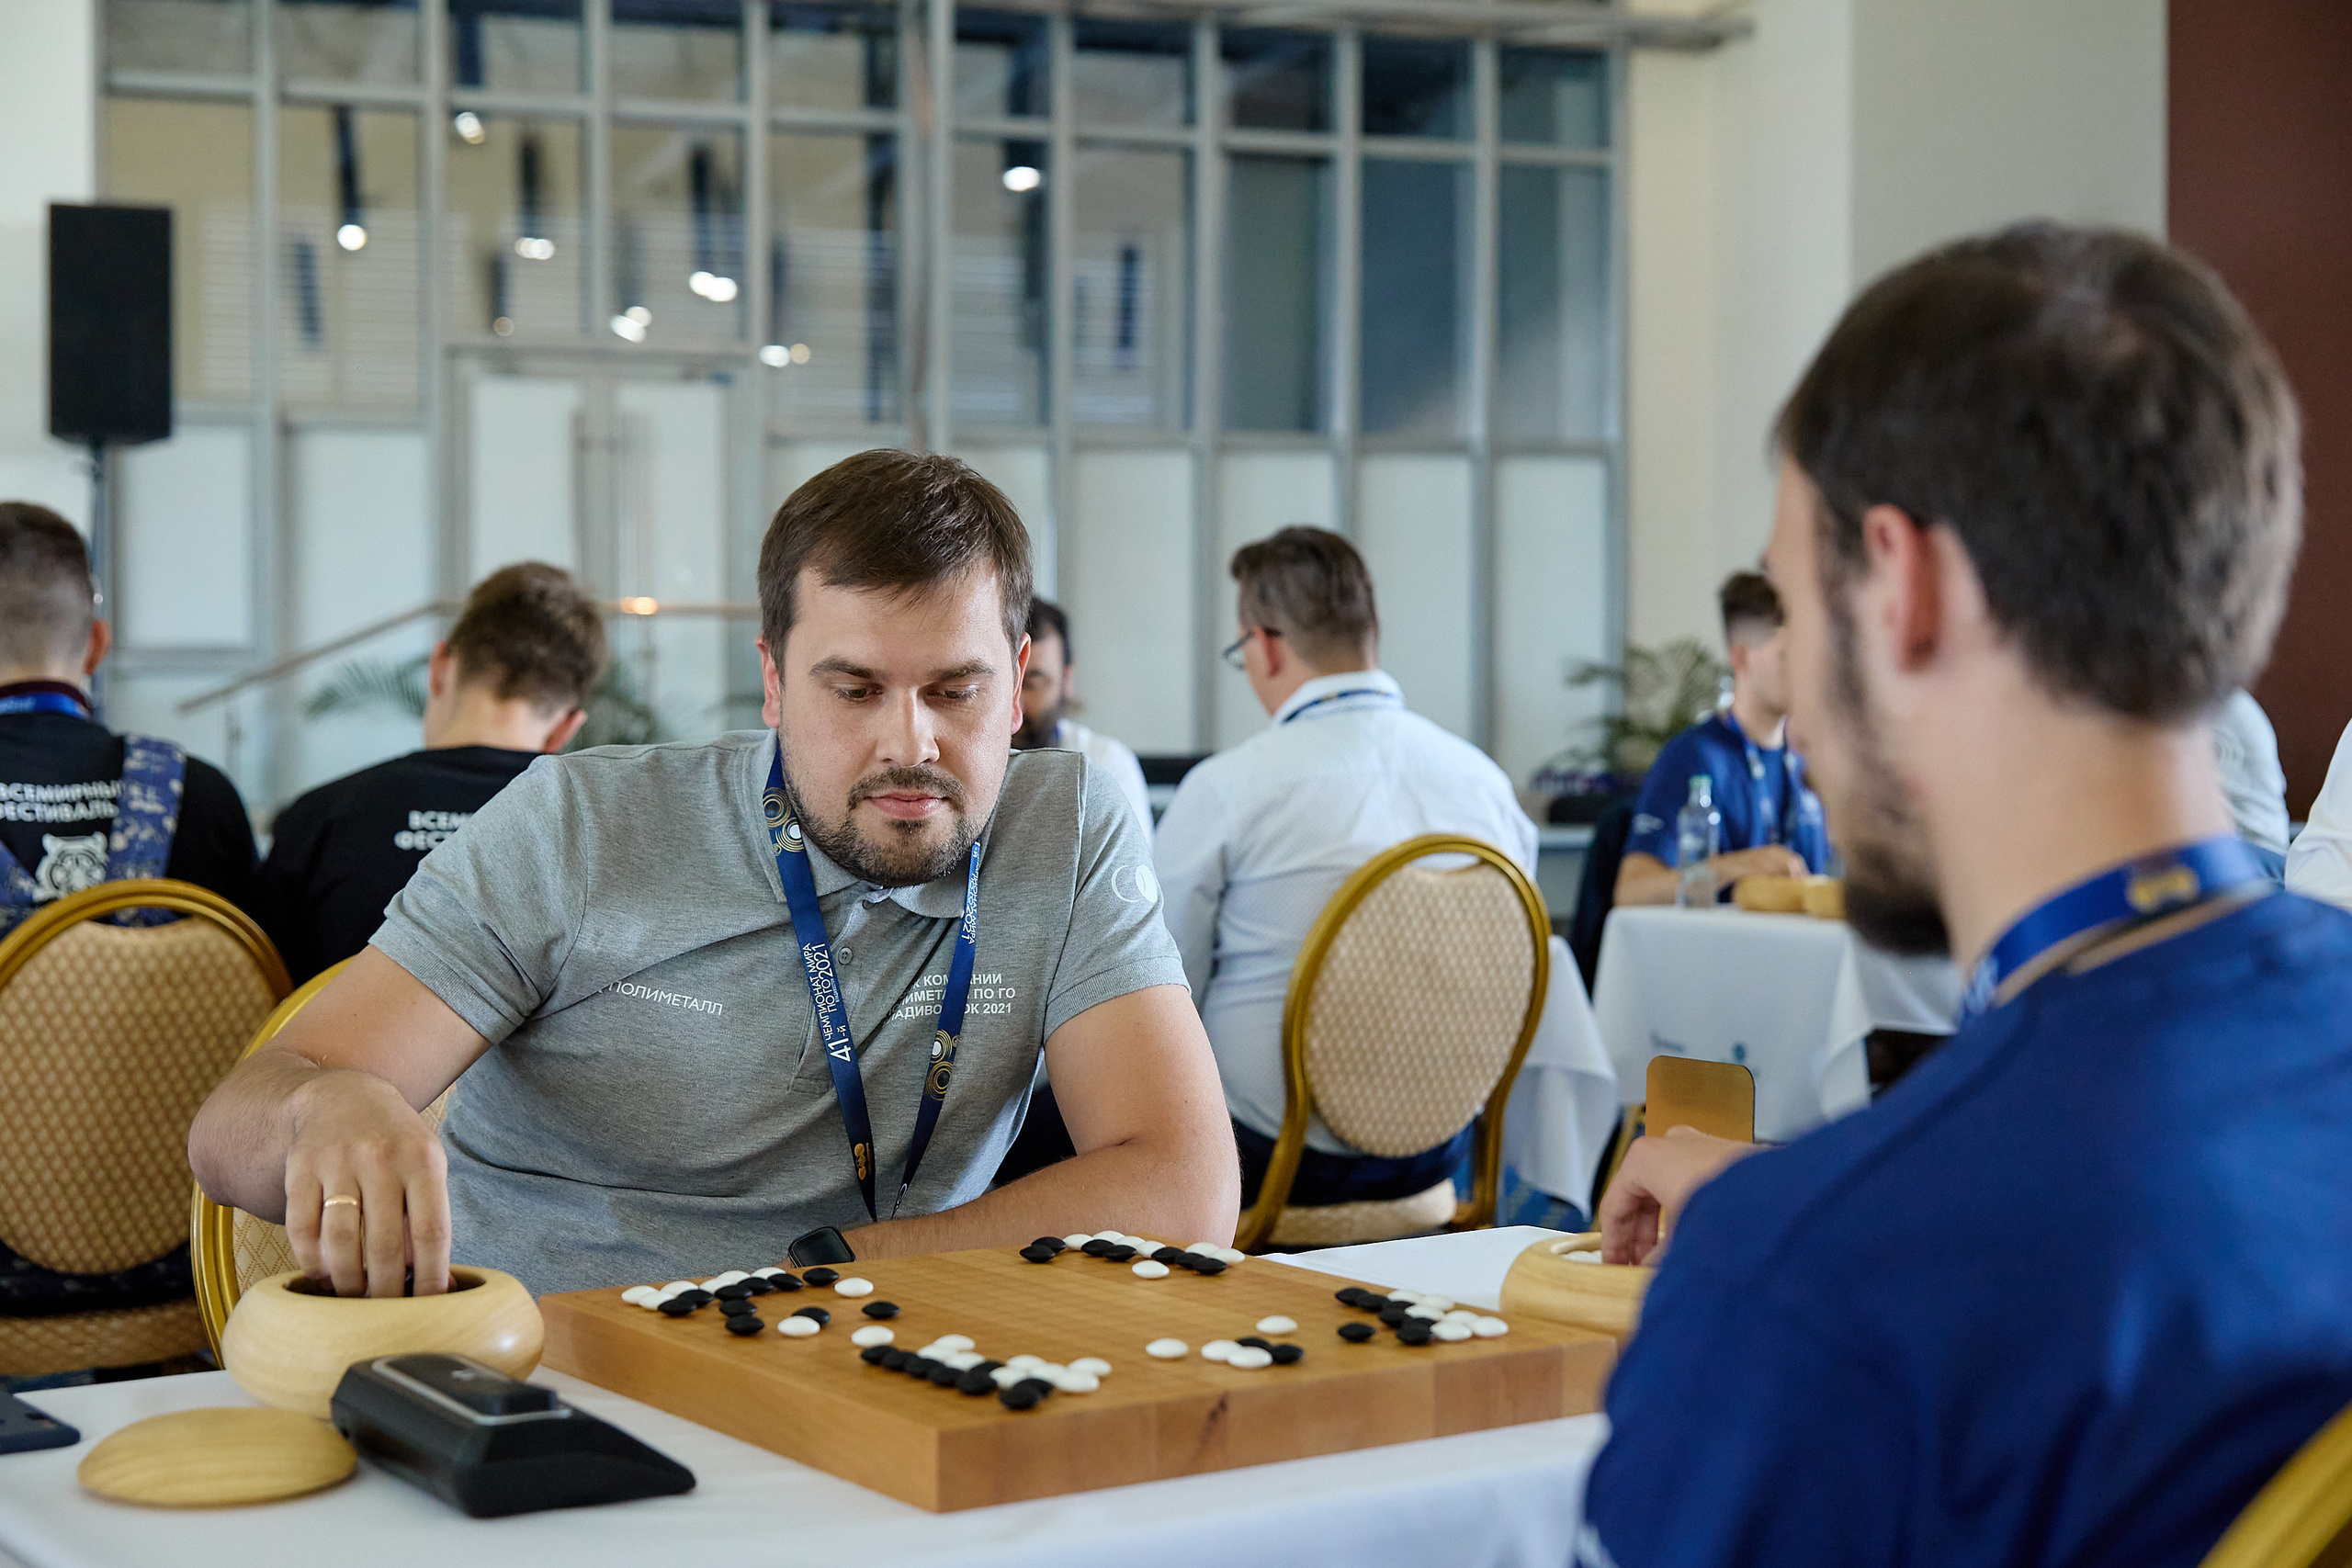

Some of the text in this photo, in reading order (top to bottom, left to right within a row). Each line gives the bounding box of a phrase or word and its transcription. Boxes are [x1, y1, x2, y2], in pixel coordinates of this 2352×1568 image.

[0, 799, 119, 822] ЕСТИВАЛЬ
[961, 904, 973, 941] 2021
[802, 942, 833, 1041] ЧЕМПИОНАТ МИРА
[811, 942, 837, 1012] ПО ГО 2021
[974, 988, 994, 999] ПО
[998, 987, 1016, 999] ГО
[982, 1002, 1012, 1014] 2021
